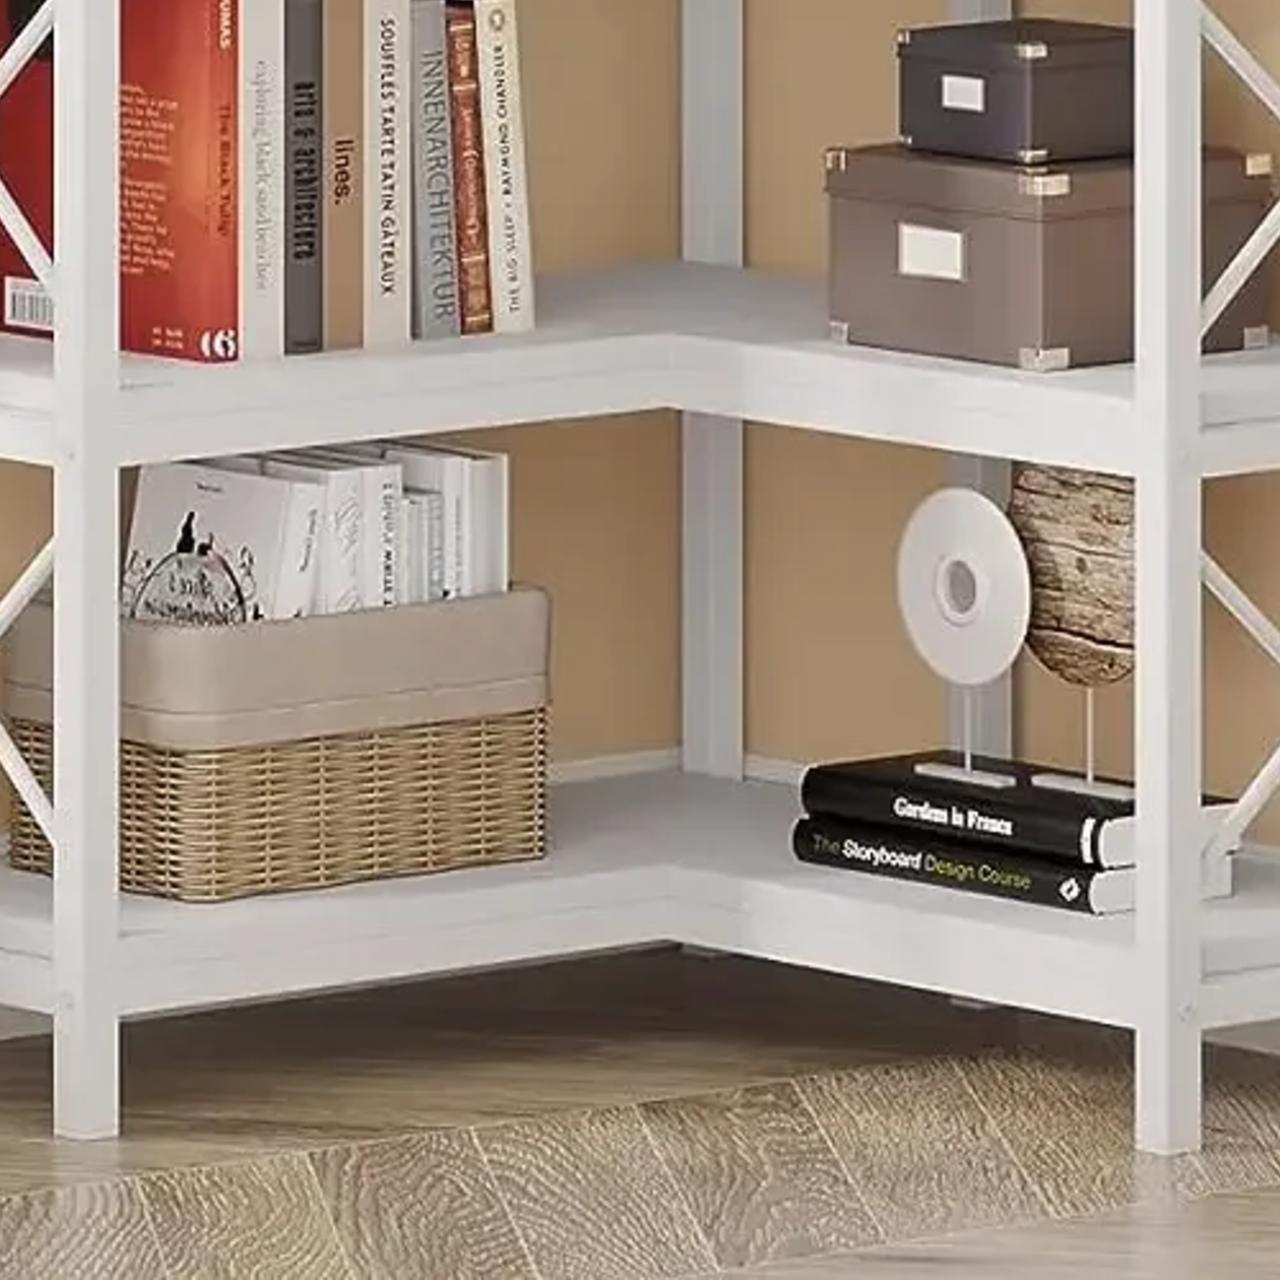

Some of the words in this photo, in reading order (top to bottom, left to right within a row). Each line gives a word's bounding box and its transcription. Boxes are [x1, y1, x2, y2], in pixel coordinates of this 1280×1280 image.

[293, 81, 318, 118] arts
[493, 44, 509, 120] CHANDLER
[380, 106, 396, 157] TARTE
[498, 124, 513, 196] RAYMOND
[334, 139, 355, 206] lines.
[380, 161, 396, 211] TATIN
[422, 50, 457, 320] INNENARCHITEKTUR
[293, 148, 319, 260] architecture
[893, 796, 949, 825] Gardens
[967, 809, 1014, 837] France
[813, 833, 840, 856] The
[841, 839, 923, 870] Storyboard
[924, 853, 976, 882] Design
[977, 863, 1033, 890] Course
